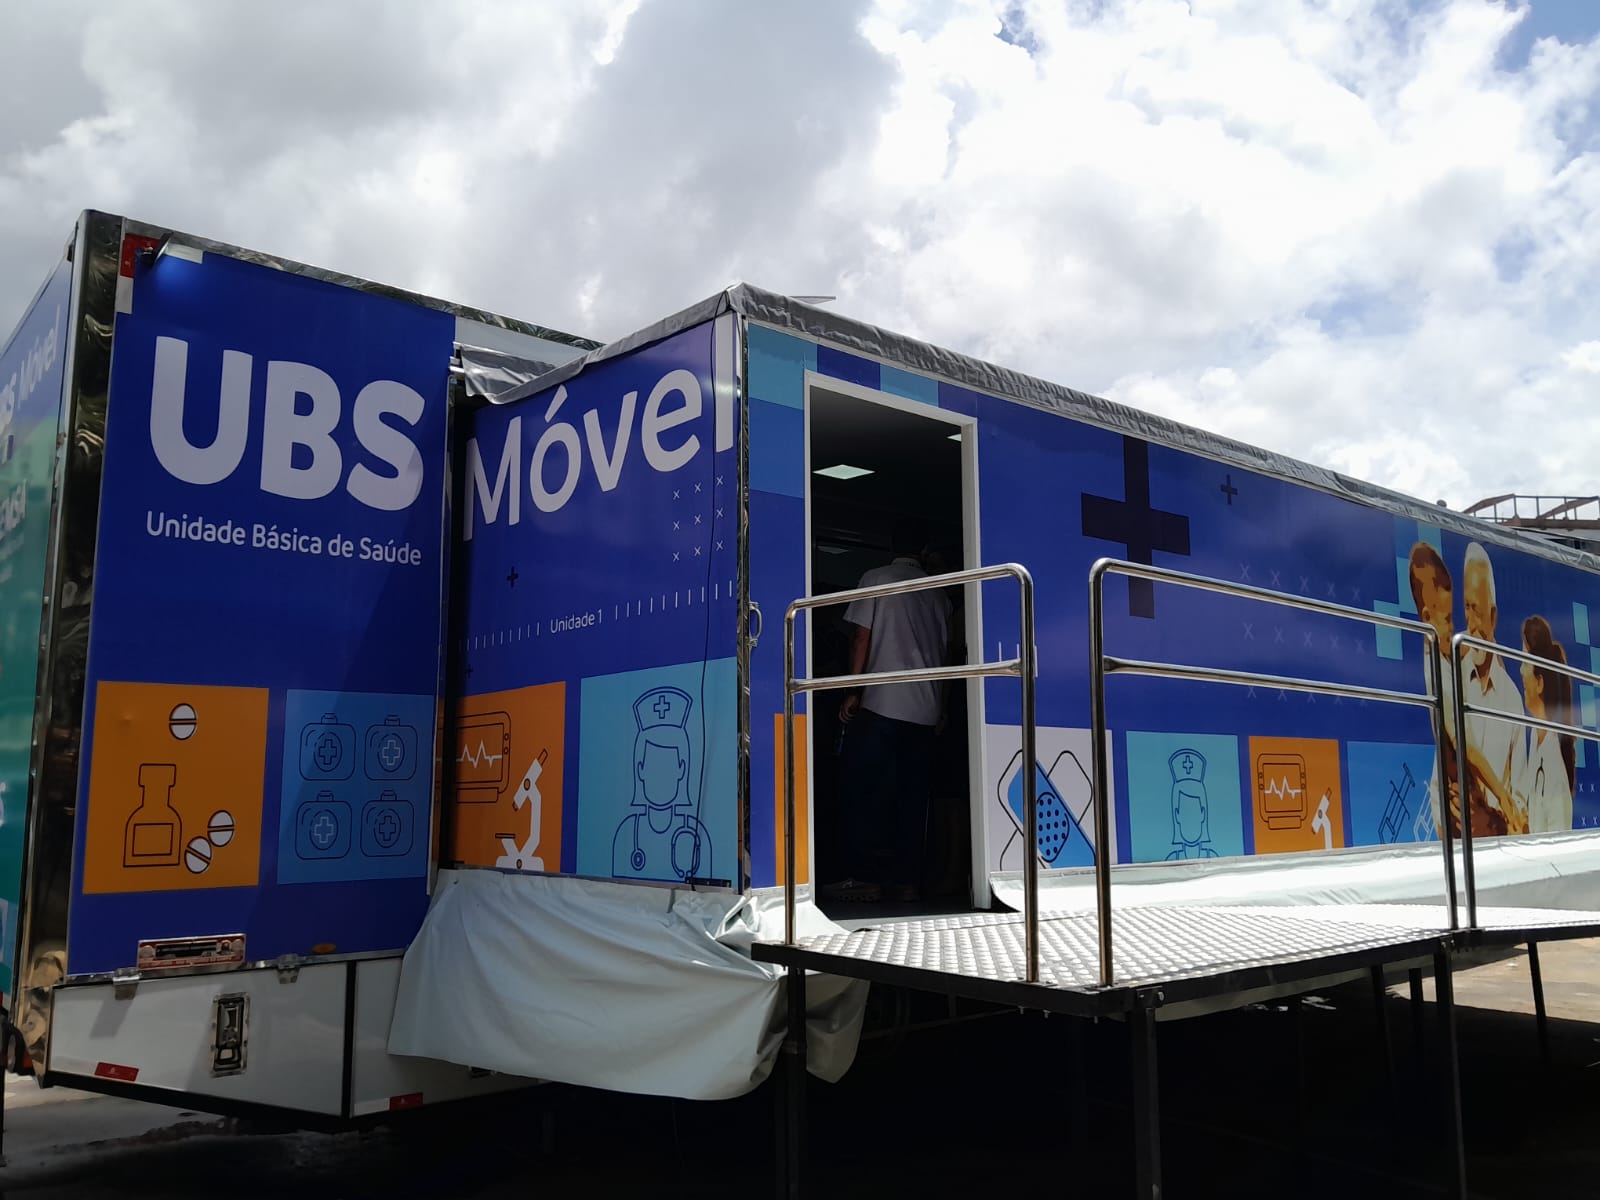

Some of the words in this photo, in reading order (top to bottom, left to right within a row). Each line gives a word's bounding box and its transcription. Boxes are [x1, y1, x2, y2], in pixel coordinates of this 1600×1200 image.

[150, 335, 425, 511] UBS
[463, 310, 734, 542] Móvel
[146, 510, 246, 545] Unidade
[252, 523, 322, 554] Básica
[328, 533, 354, 558] de
[359, 537, 422, 566] Saúde
[550, 611, 595, 634] Unidade
[598, 608, 602, 624] 1
